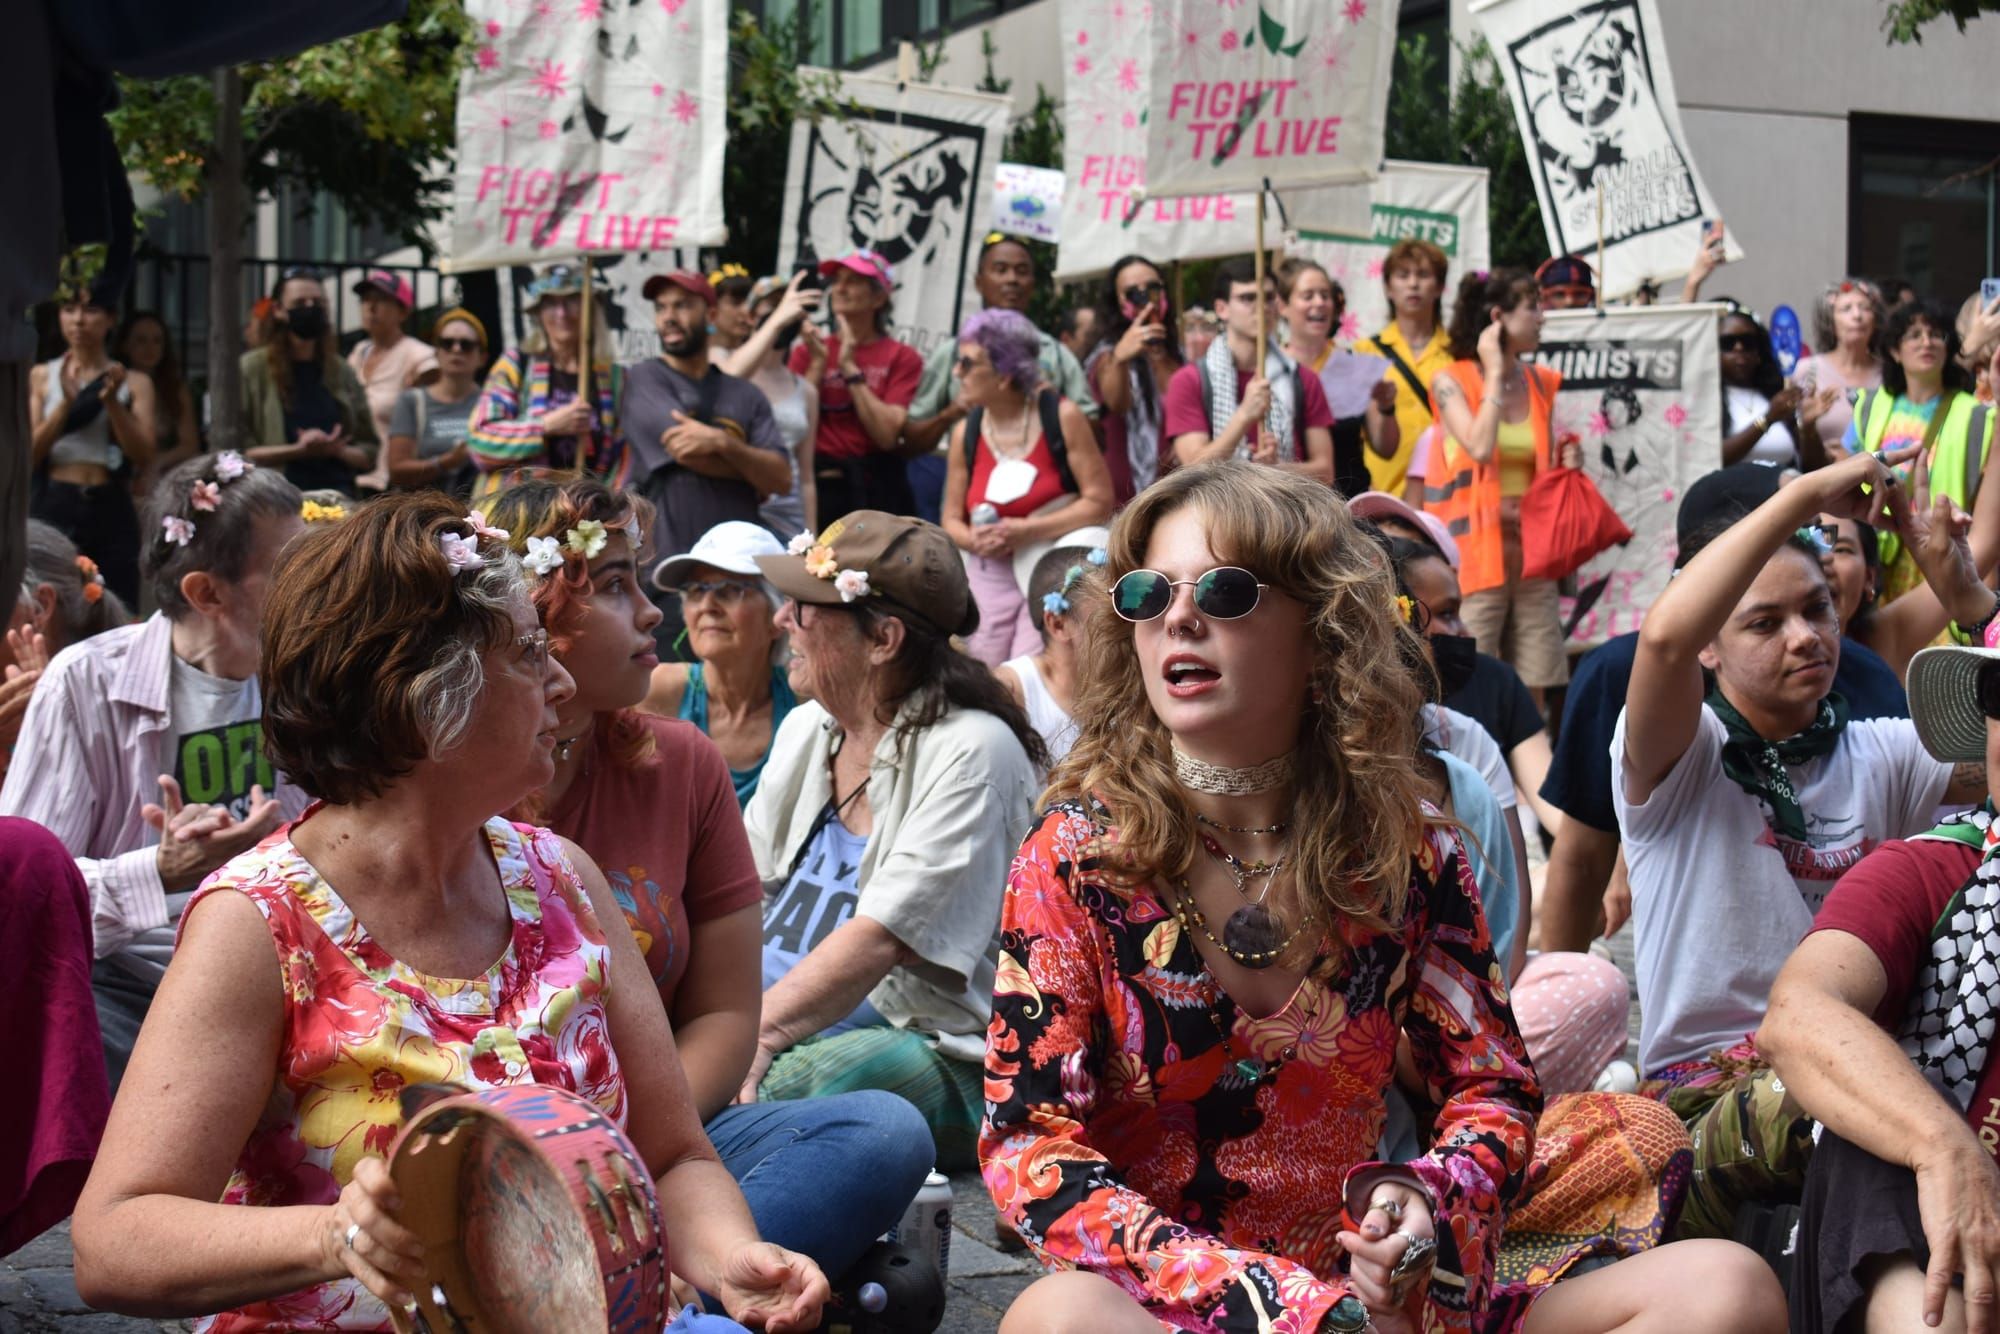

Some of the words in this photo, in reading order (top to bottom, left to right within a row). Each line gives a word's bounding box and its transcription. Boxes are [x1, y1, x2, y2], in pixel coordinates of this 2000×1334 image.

[1167, 79, 1297, 121] FIGHT
[1187, 122, 1242, 160] TO
[1253, 116, 1342, 158] LIVE
[476, 164, 624, 211] FIGHT
[1592, 145, 1684, 190] WALL
[501, 206, 562, 249] TO
[576, 213, 680, 250] LIVE
[1153, 193, 1236, 222] LIVE
[1519, 350, 1677, 379] MINISTS
